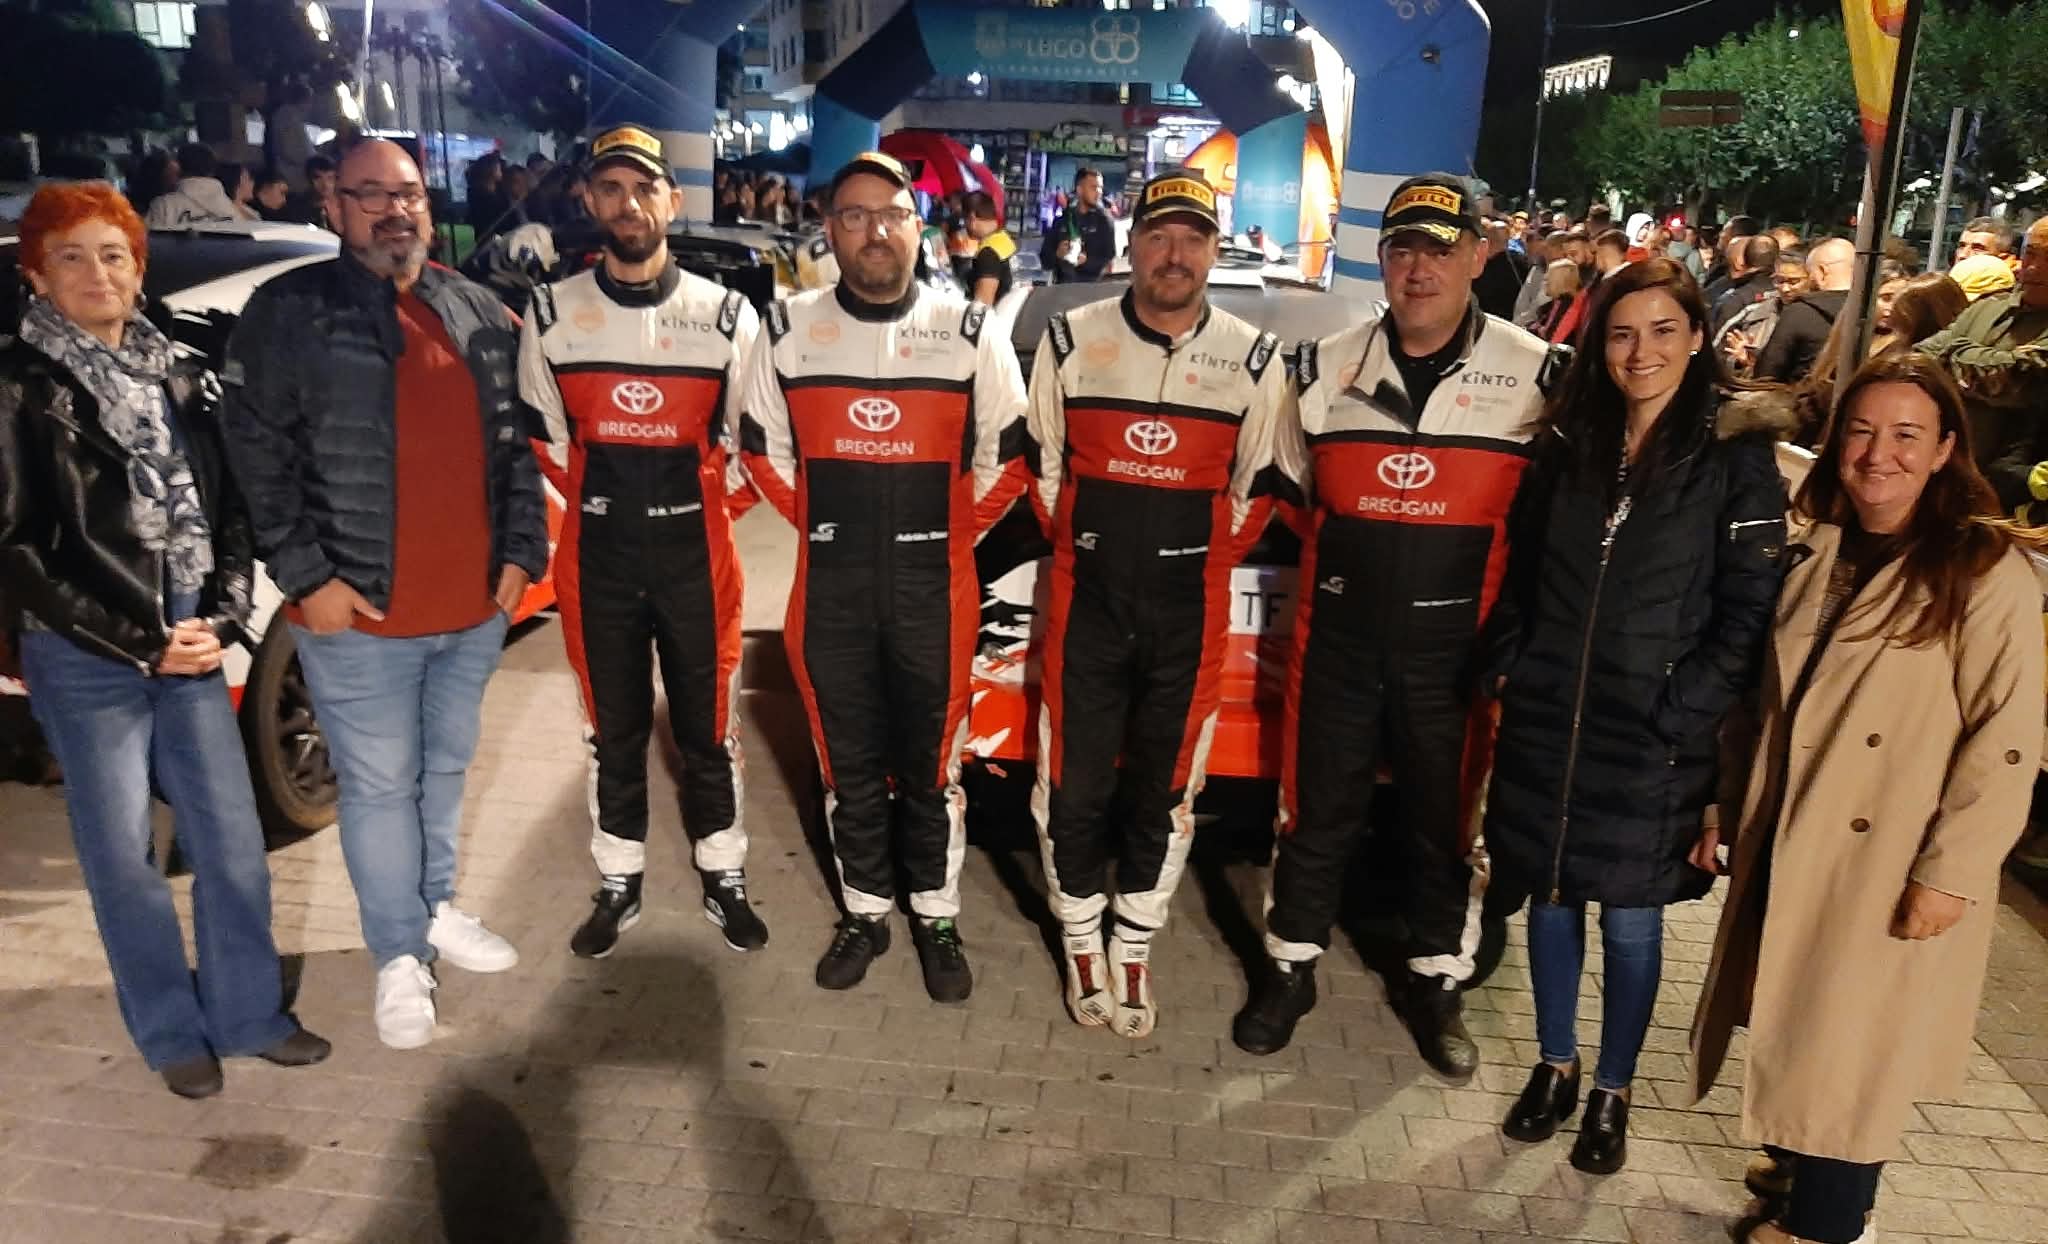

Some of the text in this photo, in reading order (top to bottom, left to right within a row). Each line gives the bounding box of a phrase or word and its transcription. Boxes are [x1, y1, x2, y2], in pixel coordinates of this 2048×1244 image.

[1026, 38, 1087, 59] LUGO
[598, 421, 678, 439] BREOGAN
[835, 439, 914, 457] BREOGAN
[1107, 459, 1187, 482] BREOGAN
[1358, 496, 1447, 516] BREOGAN
[1240, 591, 1289, 628] TF
